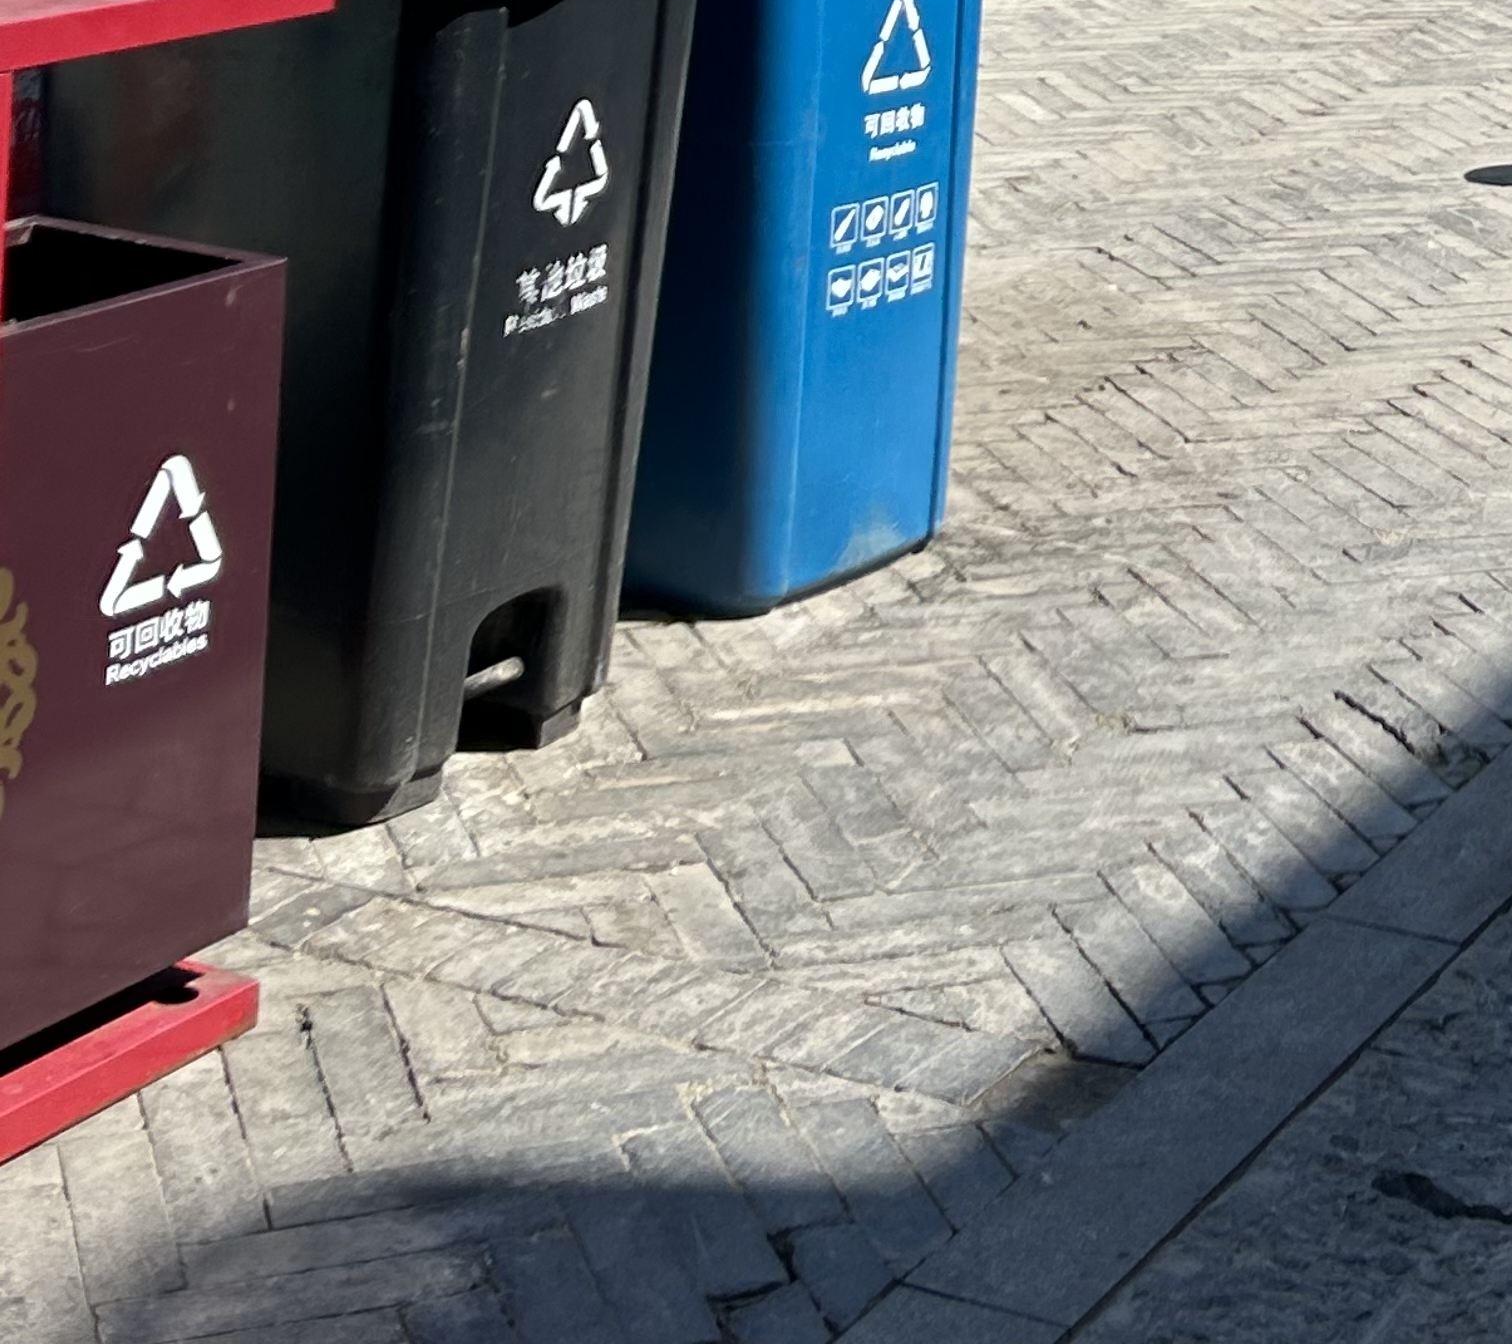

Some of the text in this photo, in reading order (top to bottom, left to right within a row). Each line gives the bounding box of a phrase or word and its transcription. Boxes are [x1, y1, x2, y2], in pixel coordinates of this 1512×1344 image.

[863, 102, 926, 139] 可回收物
[108, 599, 211, 660] 可回收物
[105, 632, 209, 687] Recyclables
